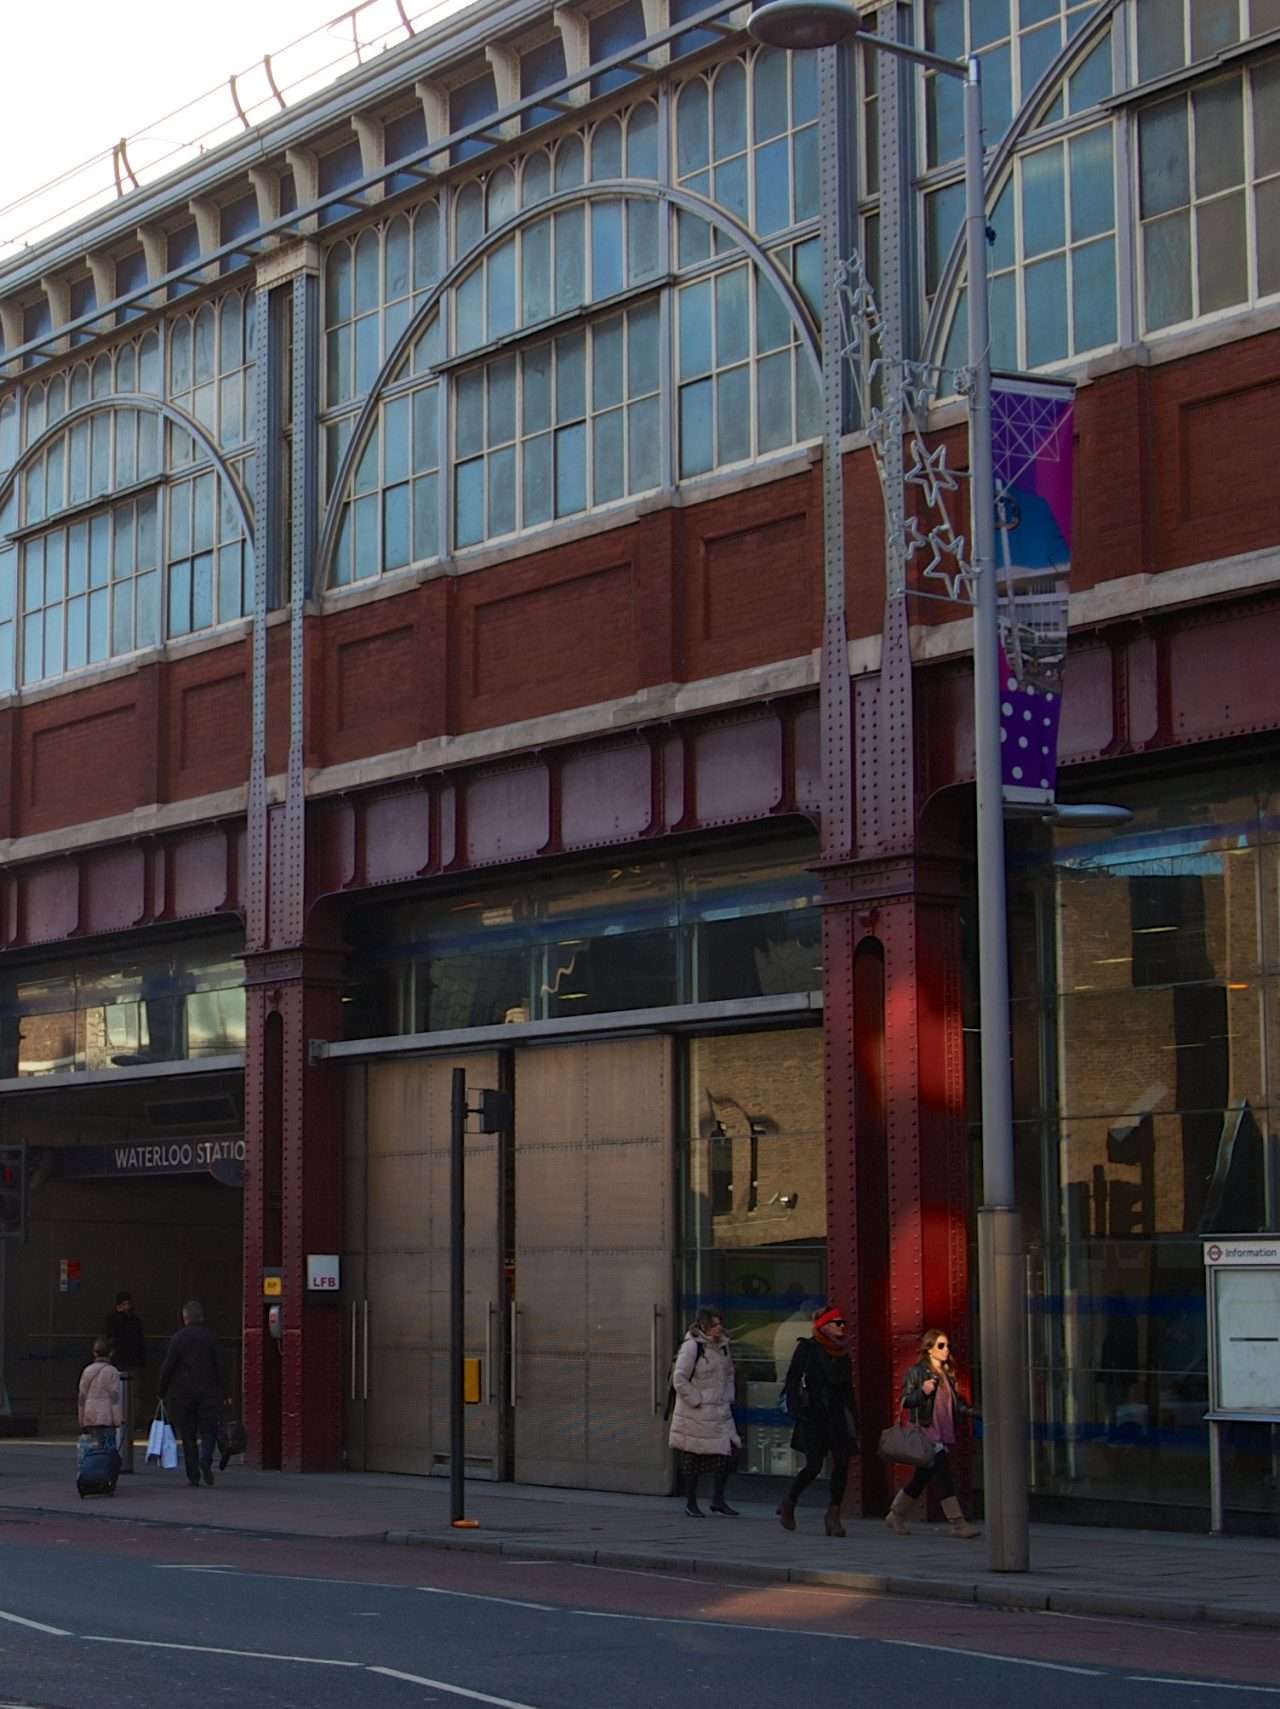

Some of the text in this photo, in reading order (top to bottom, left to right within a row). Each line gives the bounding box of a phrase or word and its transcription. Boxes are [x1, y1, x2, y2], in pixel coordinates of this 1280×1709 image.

[115, 1141, 246, 1168] WATERLOO STATIO
[1225, 1248, 1277, 1257] Information
[313, 1277, 336, 1288] LFB
